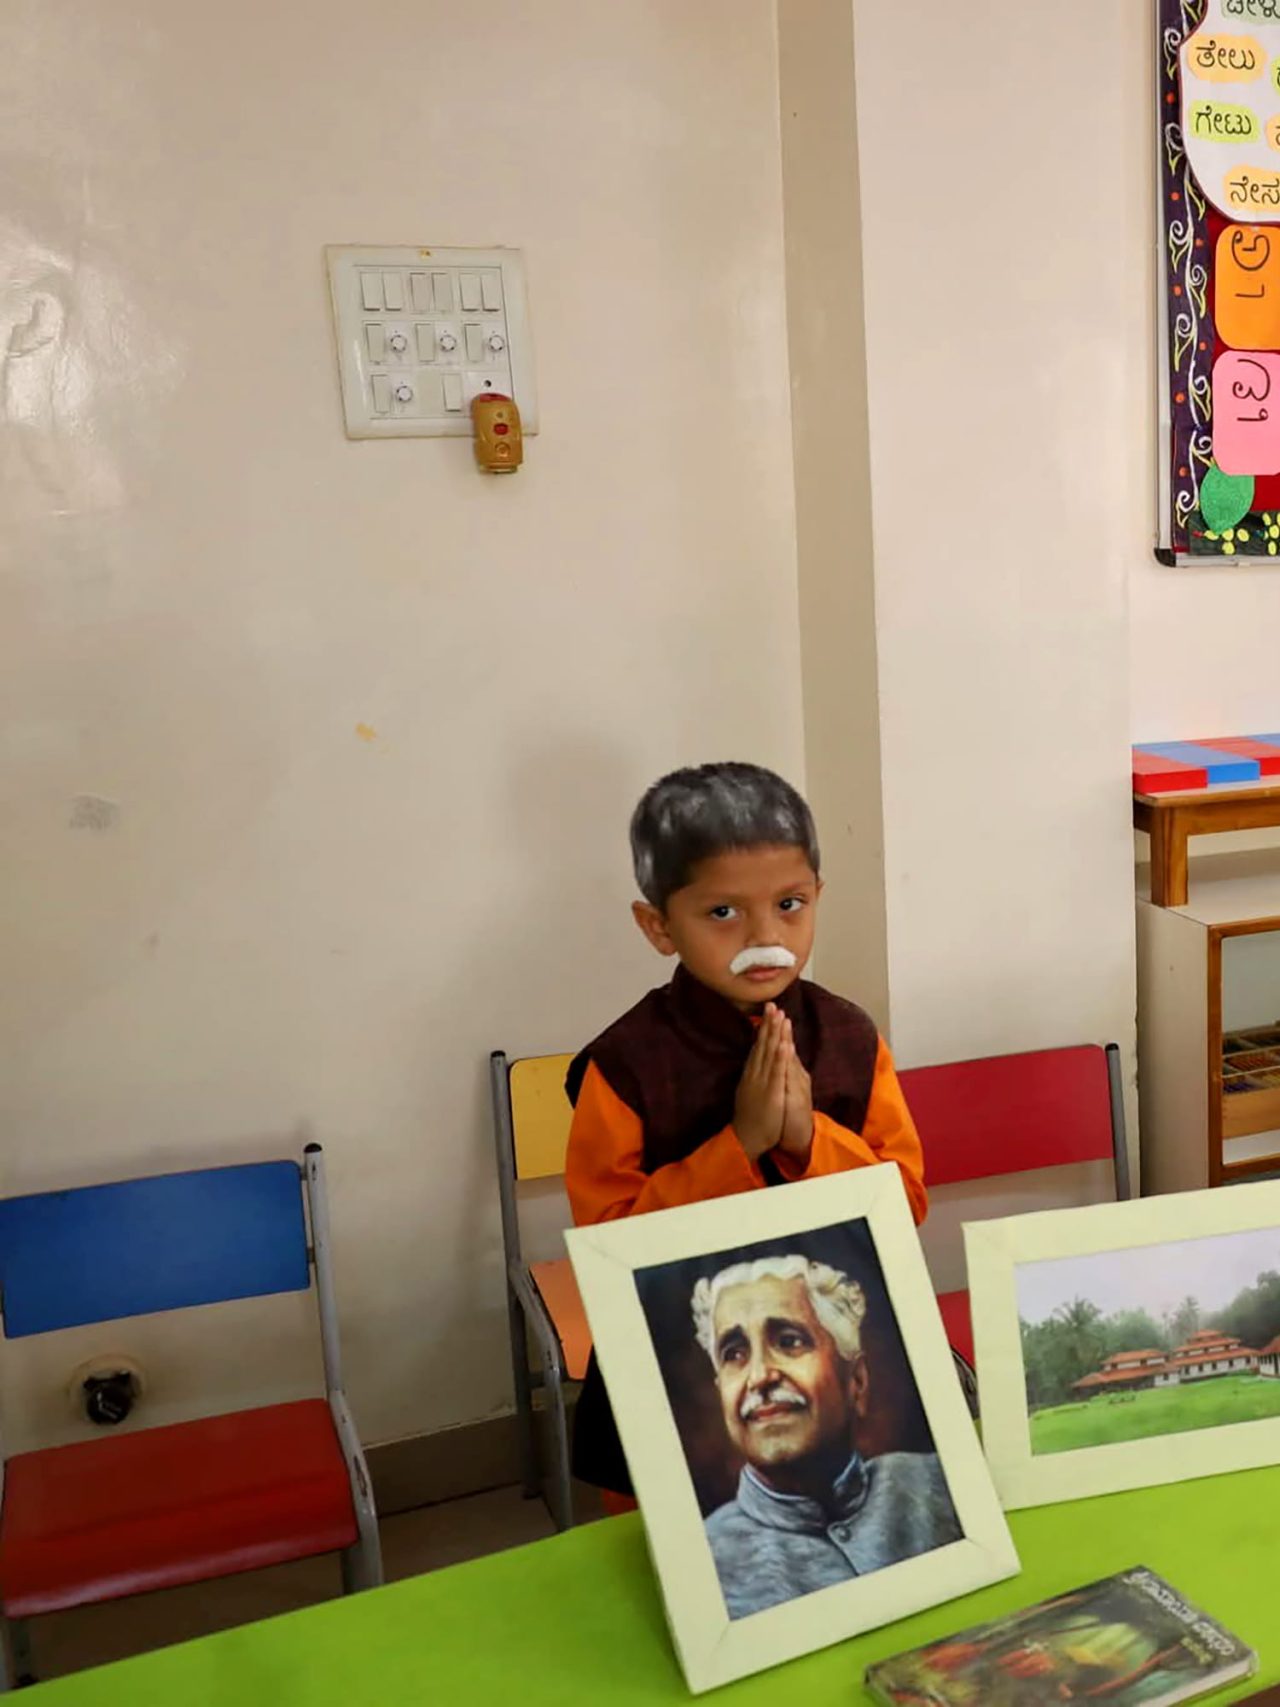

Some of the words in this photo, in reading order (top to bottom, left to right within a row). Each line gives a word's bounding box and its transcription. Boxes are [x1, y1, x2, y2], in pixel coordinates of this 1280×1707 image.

[1196, 40, 1255, 70] ತೇಲು
[1195, 105, 1251, 135] ಗೇಟು
[1232, 230, 1271, 271] ಅ
[1232, 358, 1271, 401] ಎ
